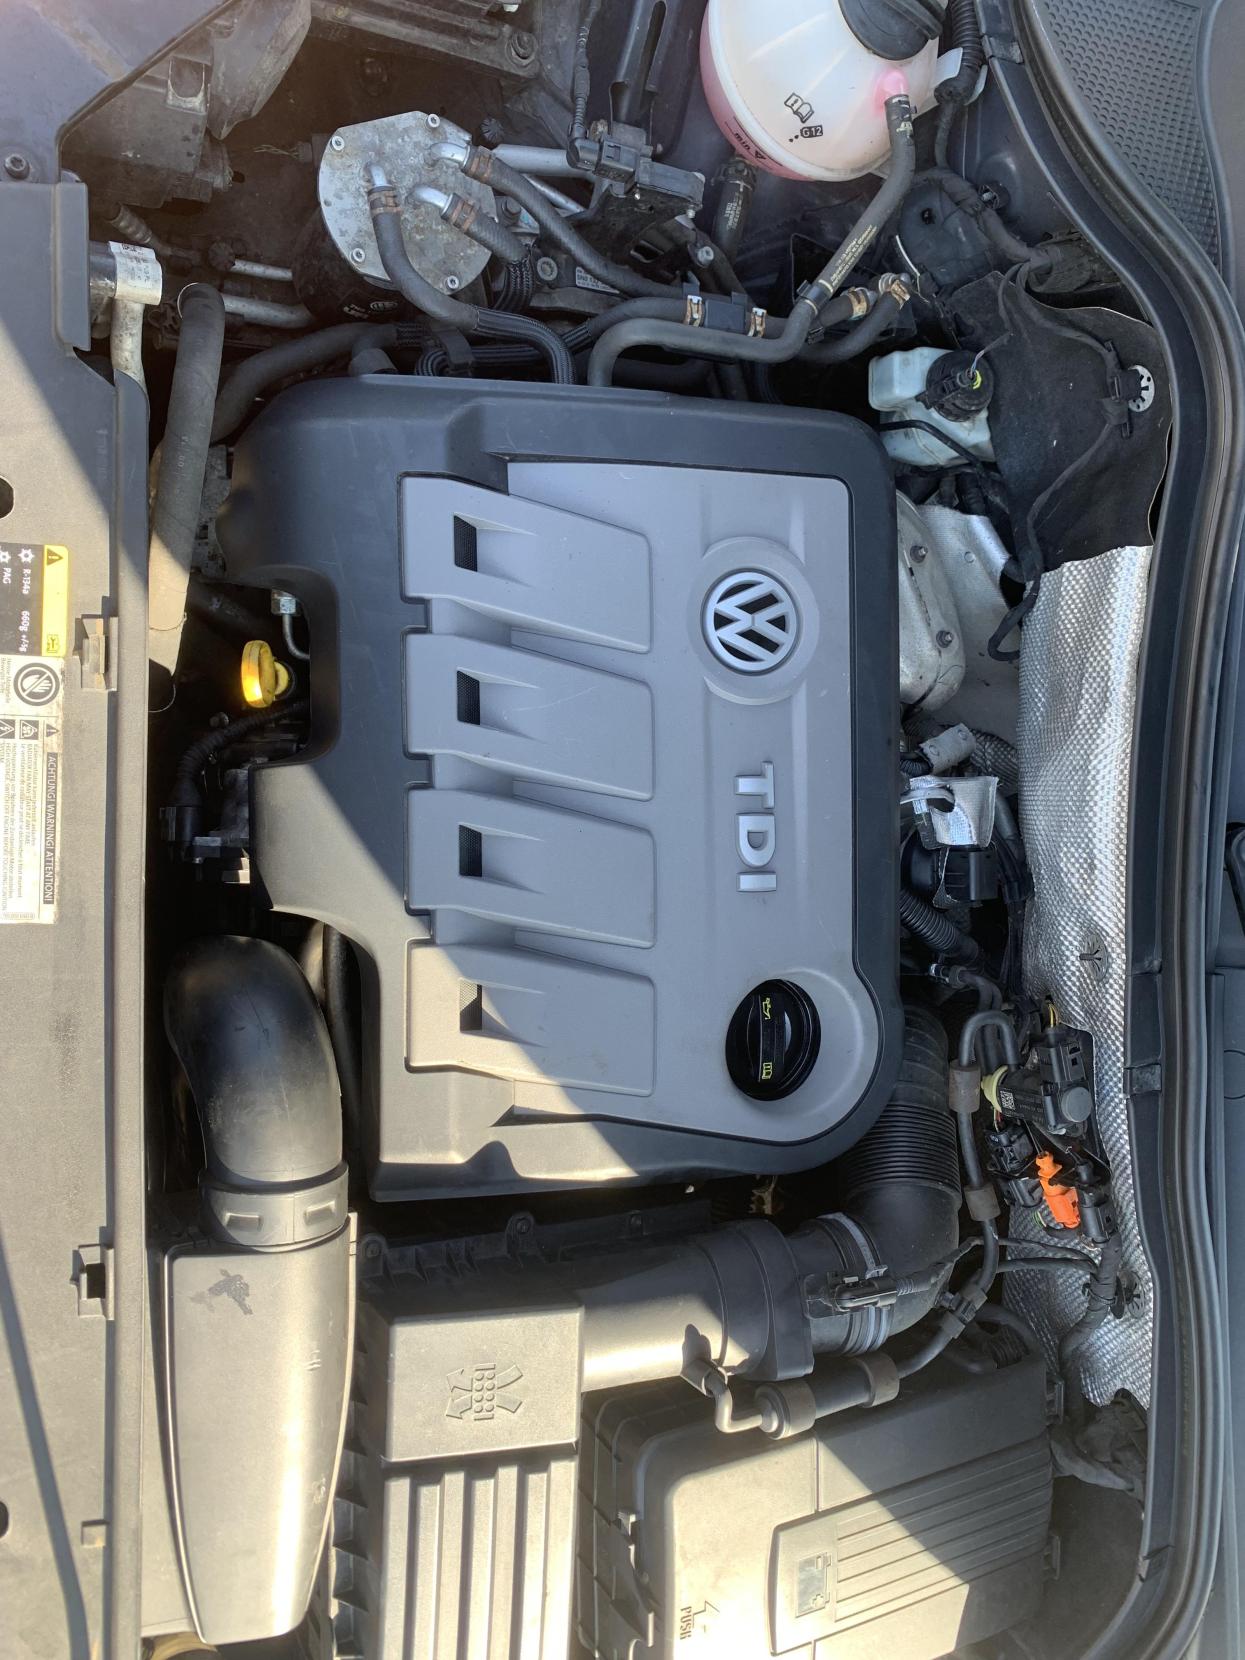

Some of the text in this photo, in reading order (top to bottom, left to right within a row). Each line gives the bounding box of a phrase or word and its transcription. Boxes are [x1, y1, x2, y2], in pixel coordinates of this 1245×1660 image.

[734, 132, 750, 150] min
[802, 126, 822, 137] G12
[2, 567, 11, 584] PAG
[22, 568, 31, 594] R-134a
[19, 610, 30, 632] 660g
[44, 756, 56, 900] ACHTUNG! WARNING! ATTENTION!
[735, 761, 777, 892] TDI
[680, 1606, 692, 1640] PUSH
